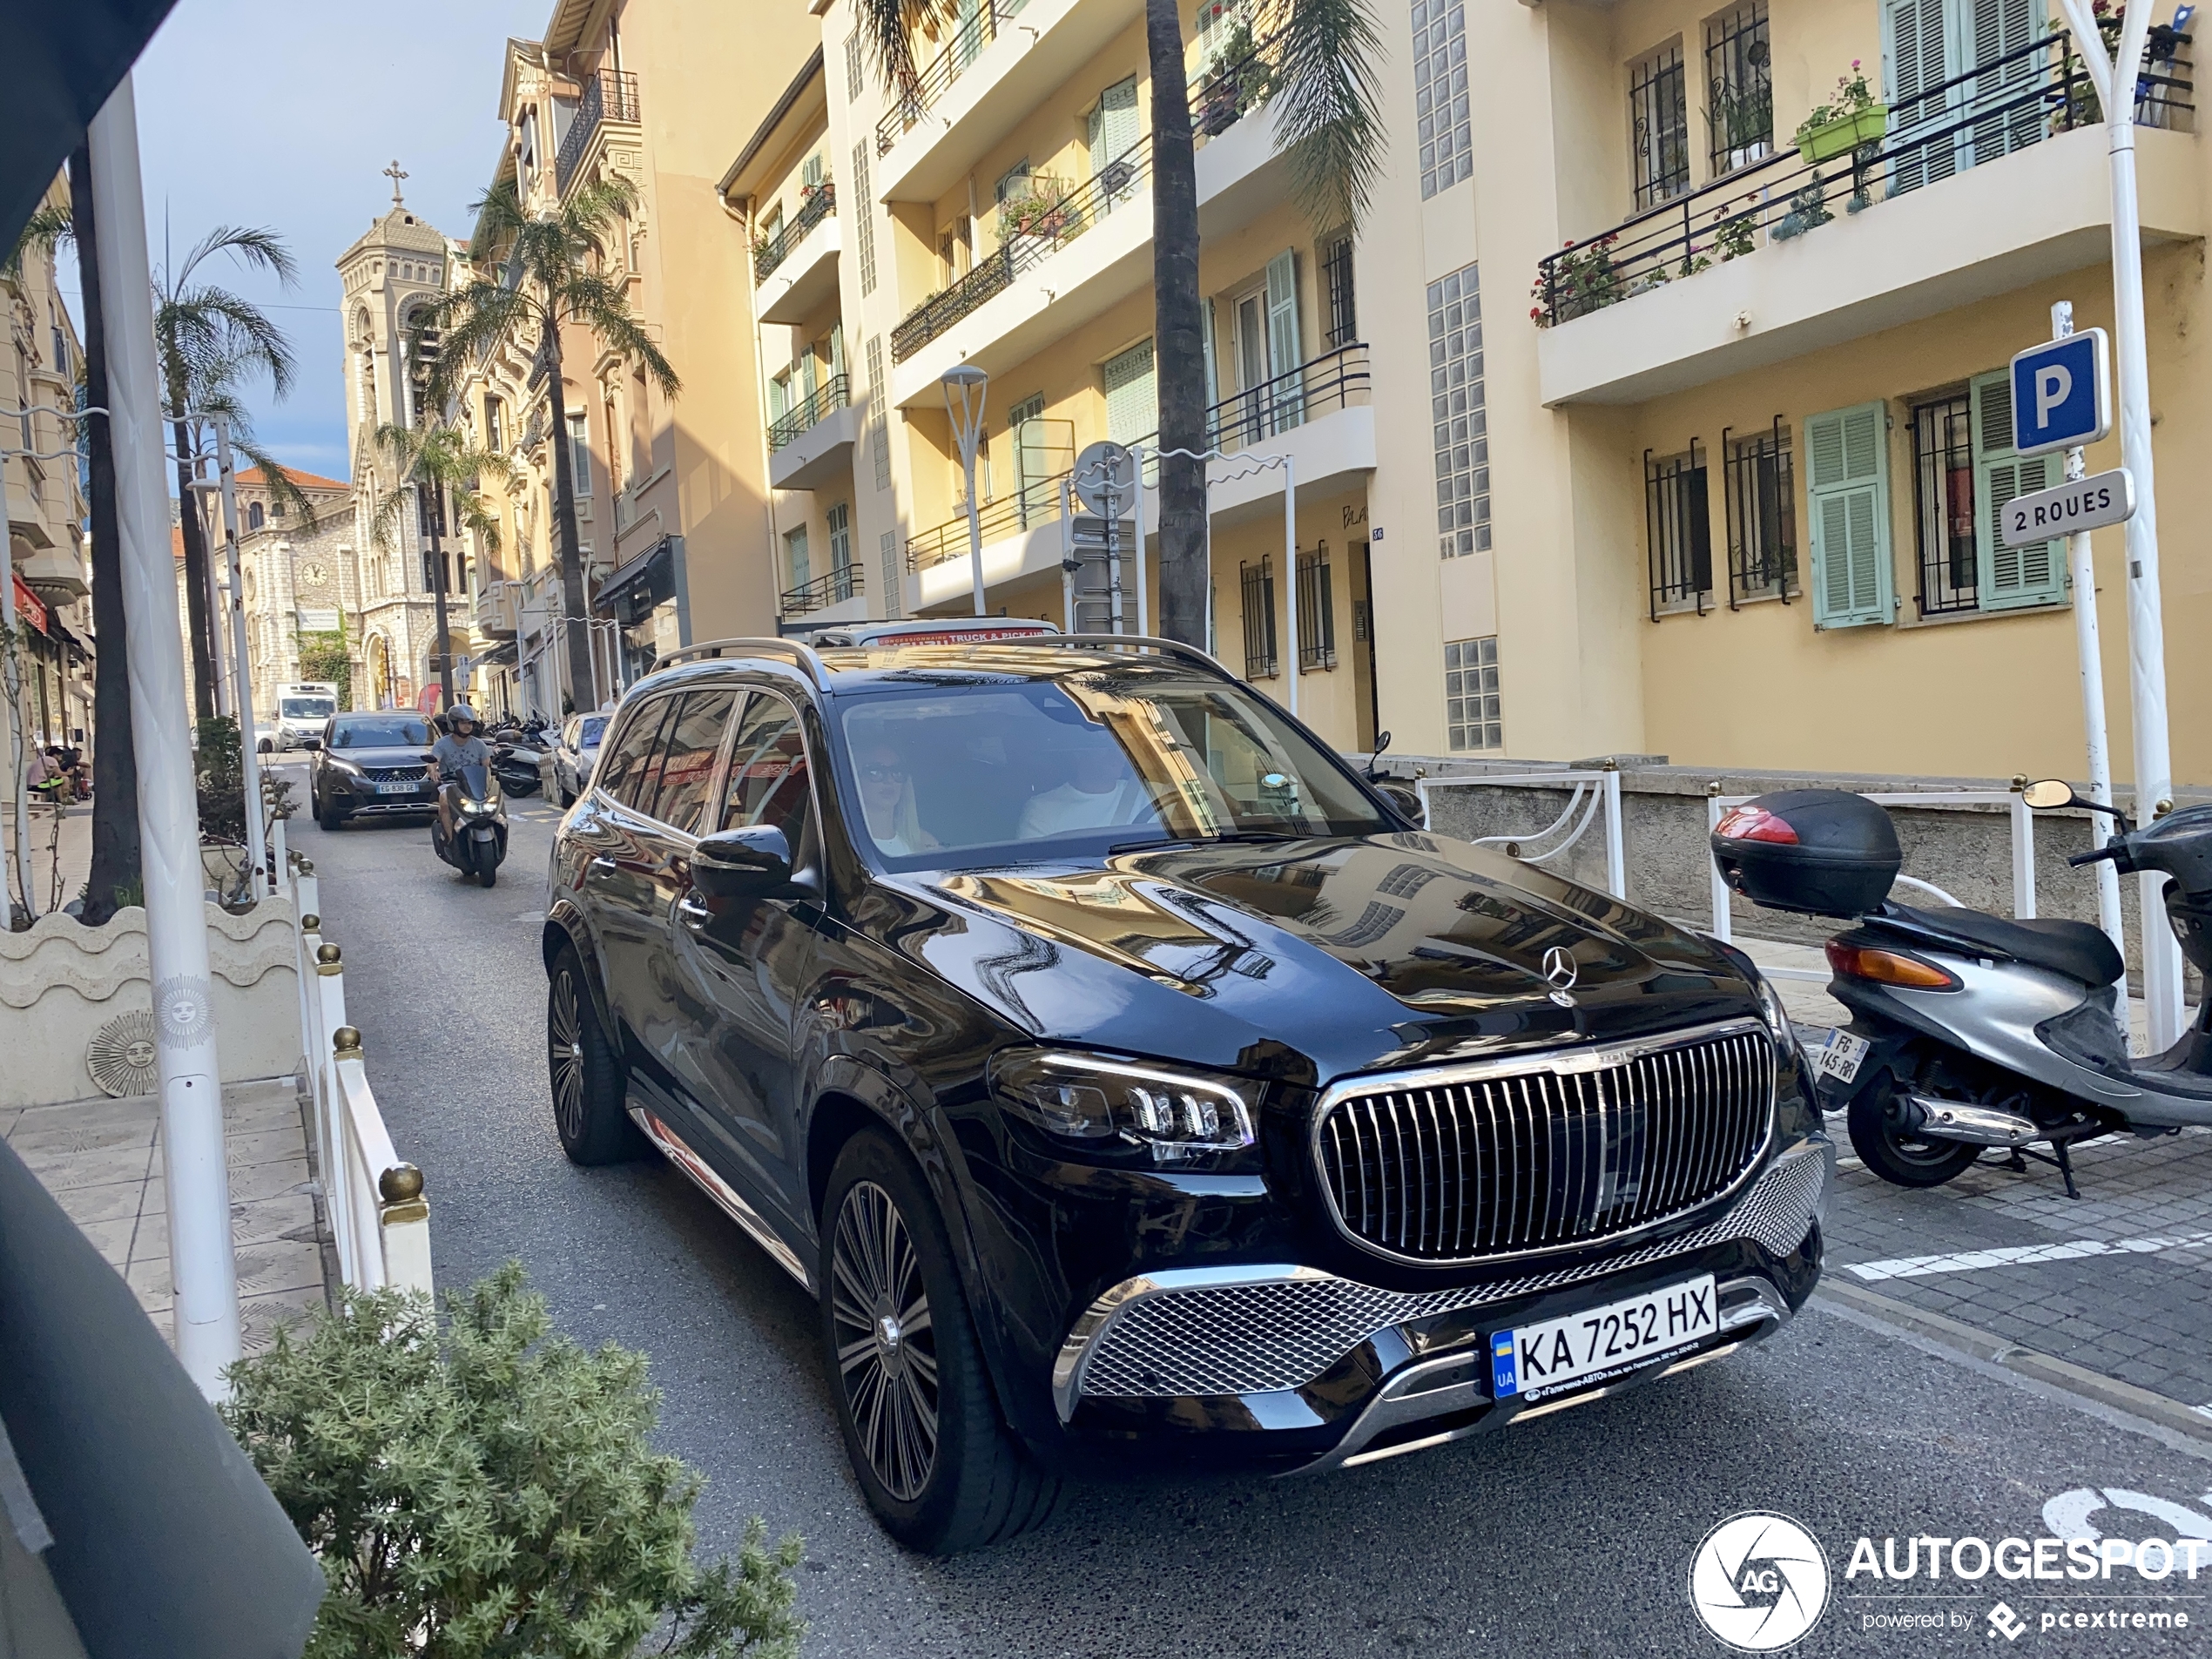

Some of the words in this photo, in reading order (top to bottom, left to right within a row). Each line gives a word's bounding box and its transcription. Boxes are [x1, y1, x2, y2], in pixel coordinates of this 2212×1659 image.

[2034, 364, 2073, 429] P
[2014, 512, 2027, 532] 2
[2034, 488, 2111, 527] ROUES
[1373, 529, 1383, 540] 36
[879, 636, 947, 644] CONCESSIONNAIRE
[949, 633, 988, 642] TRUCK
[1497, 1374, 1514, 1388] UA
[1521, 1328, 1575, 1380] KA
[1583, 1303, 1659, 1363] 7252
[1668, 1285, 1711, 1337] HX
